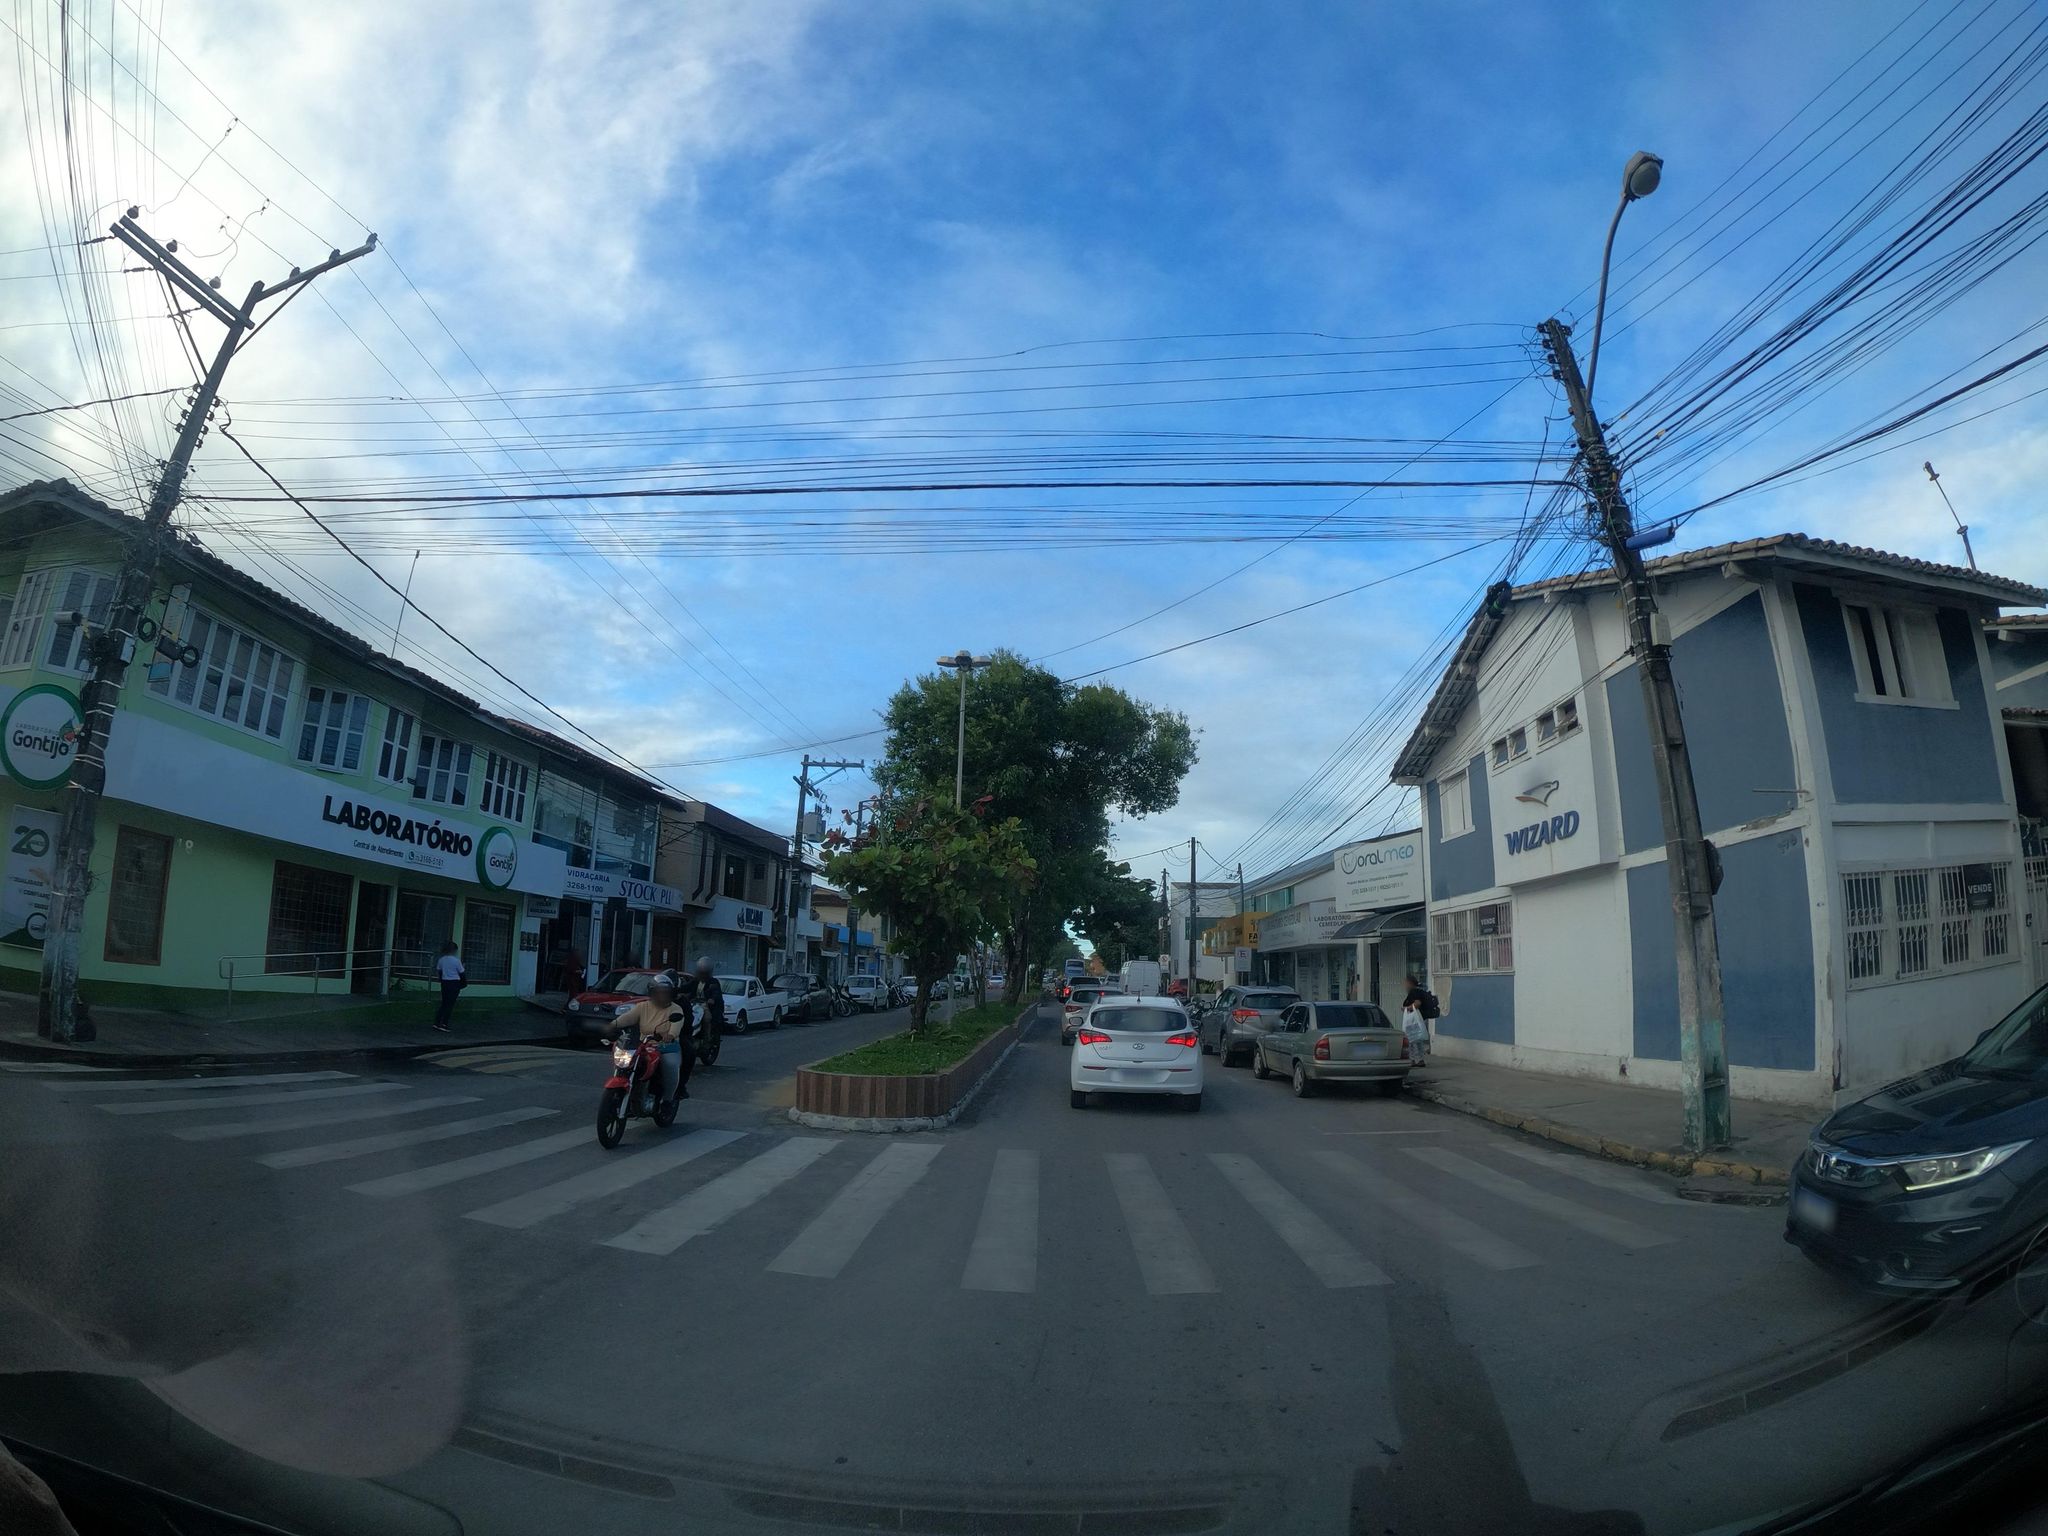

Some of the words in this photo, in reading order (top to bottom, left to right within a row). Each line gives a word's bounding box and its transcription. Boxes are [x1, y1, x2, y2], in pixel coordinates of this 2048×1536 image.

[13, 730, 70, 760] Gontijo
[322, 795, 473, 857] LABORATÓRIO
[1504, 810, 1580, 856] WIZARD
[12, 825, 50, 858] 20
[353, 839, 371, 850] Central
[370, 844, 377, 852] de
[567, 869, 610, 883] VIDRAÇARIA
[1967, 883, 1992, 894] VENDE
[619, 880, 658, 903] STOCK
